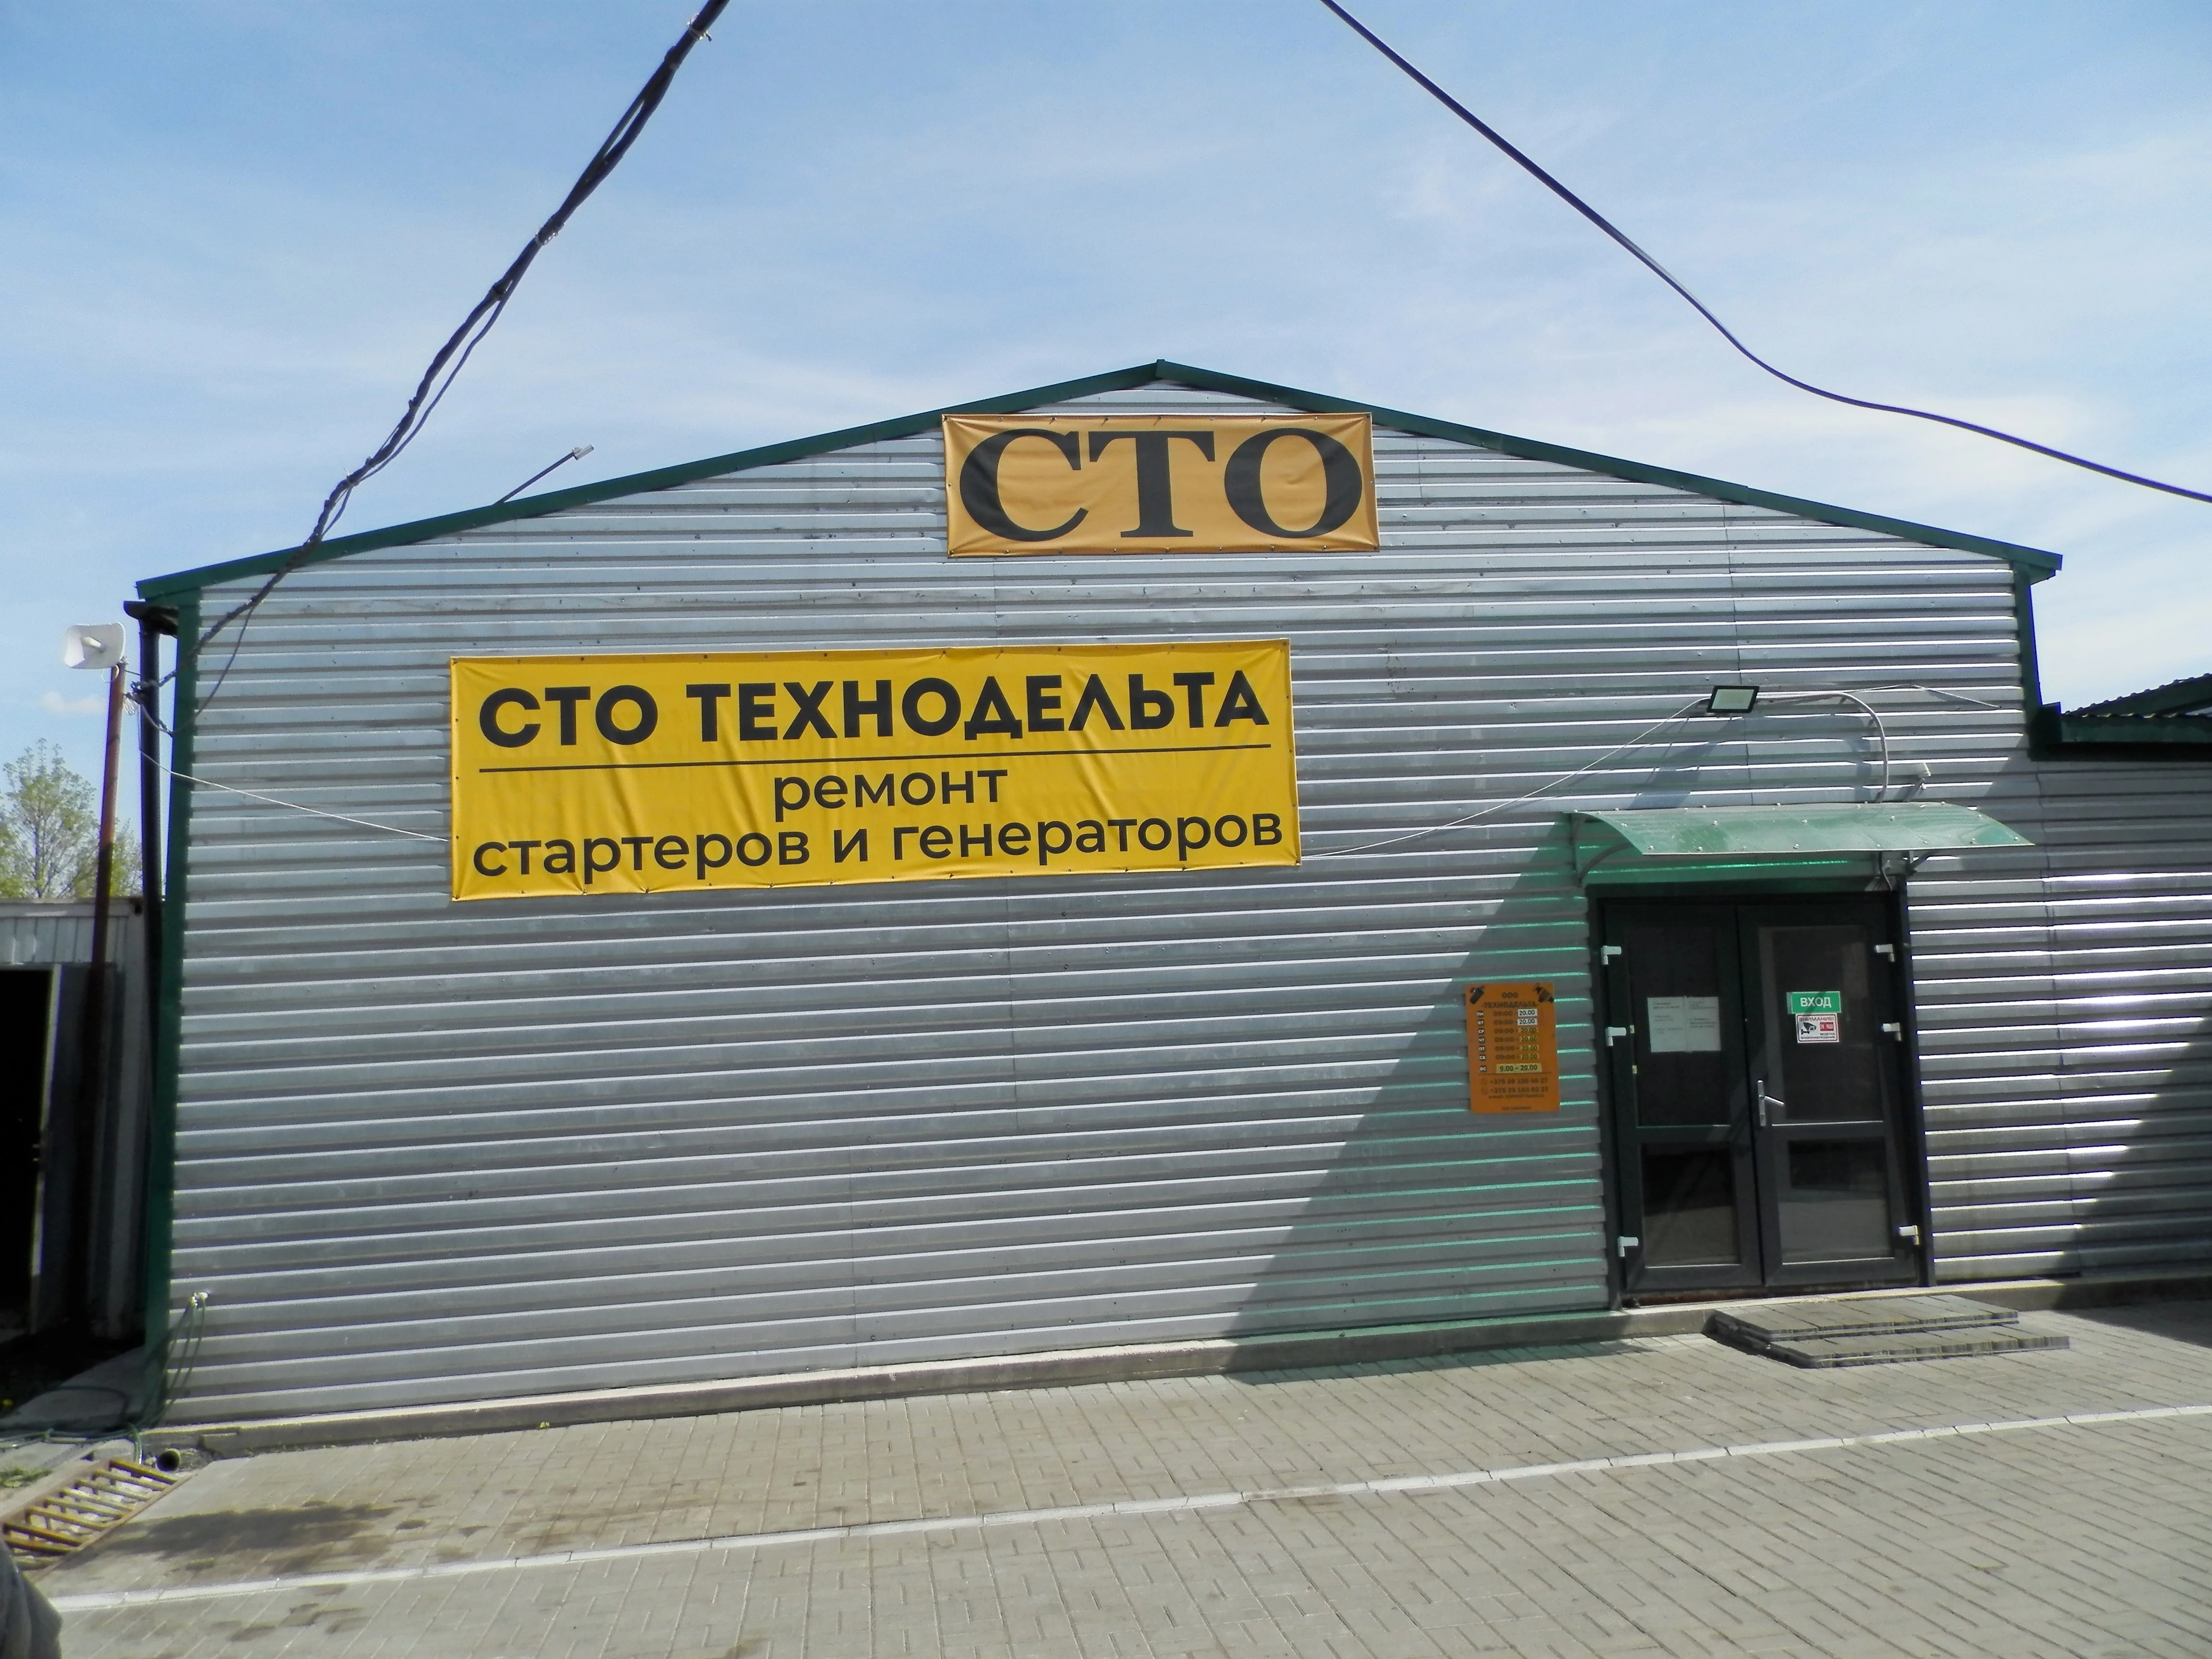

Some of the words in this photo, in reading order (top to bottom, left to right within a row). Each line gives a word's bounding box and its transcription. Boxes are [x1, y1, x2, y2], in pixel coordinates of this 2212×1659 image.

[960, 427, 1363, 542] СТО
[479, 685, 658, 748] СТО
[686, 670, 1270, 742] ТЕХНОДЕЛЬТА
[774, 769, 1008, 822] ремонт
[473, 831, 810, 885] стартеров
[834, 828, 868, 863] и
[893, 812, 1283, 866] генераторов
[1800, 997, 1832, 1008] ВХОД
